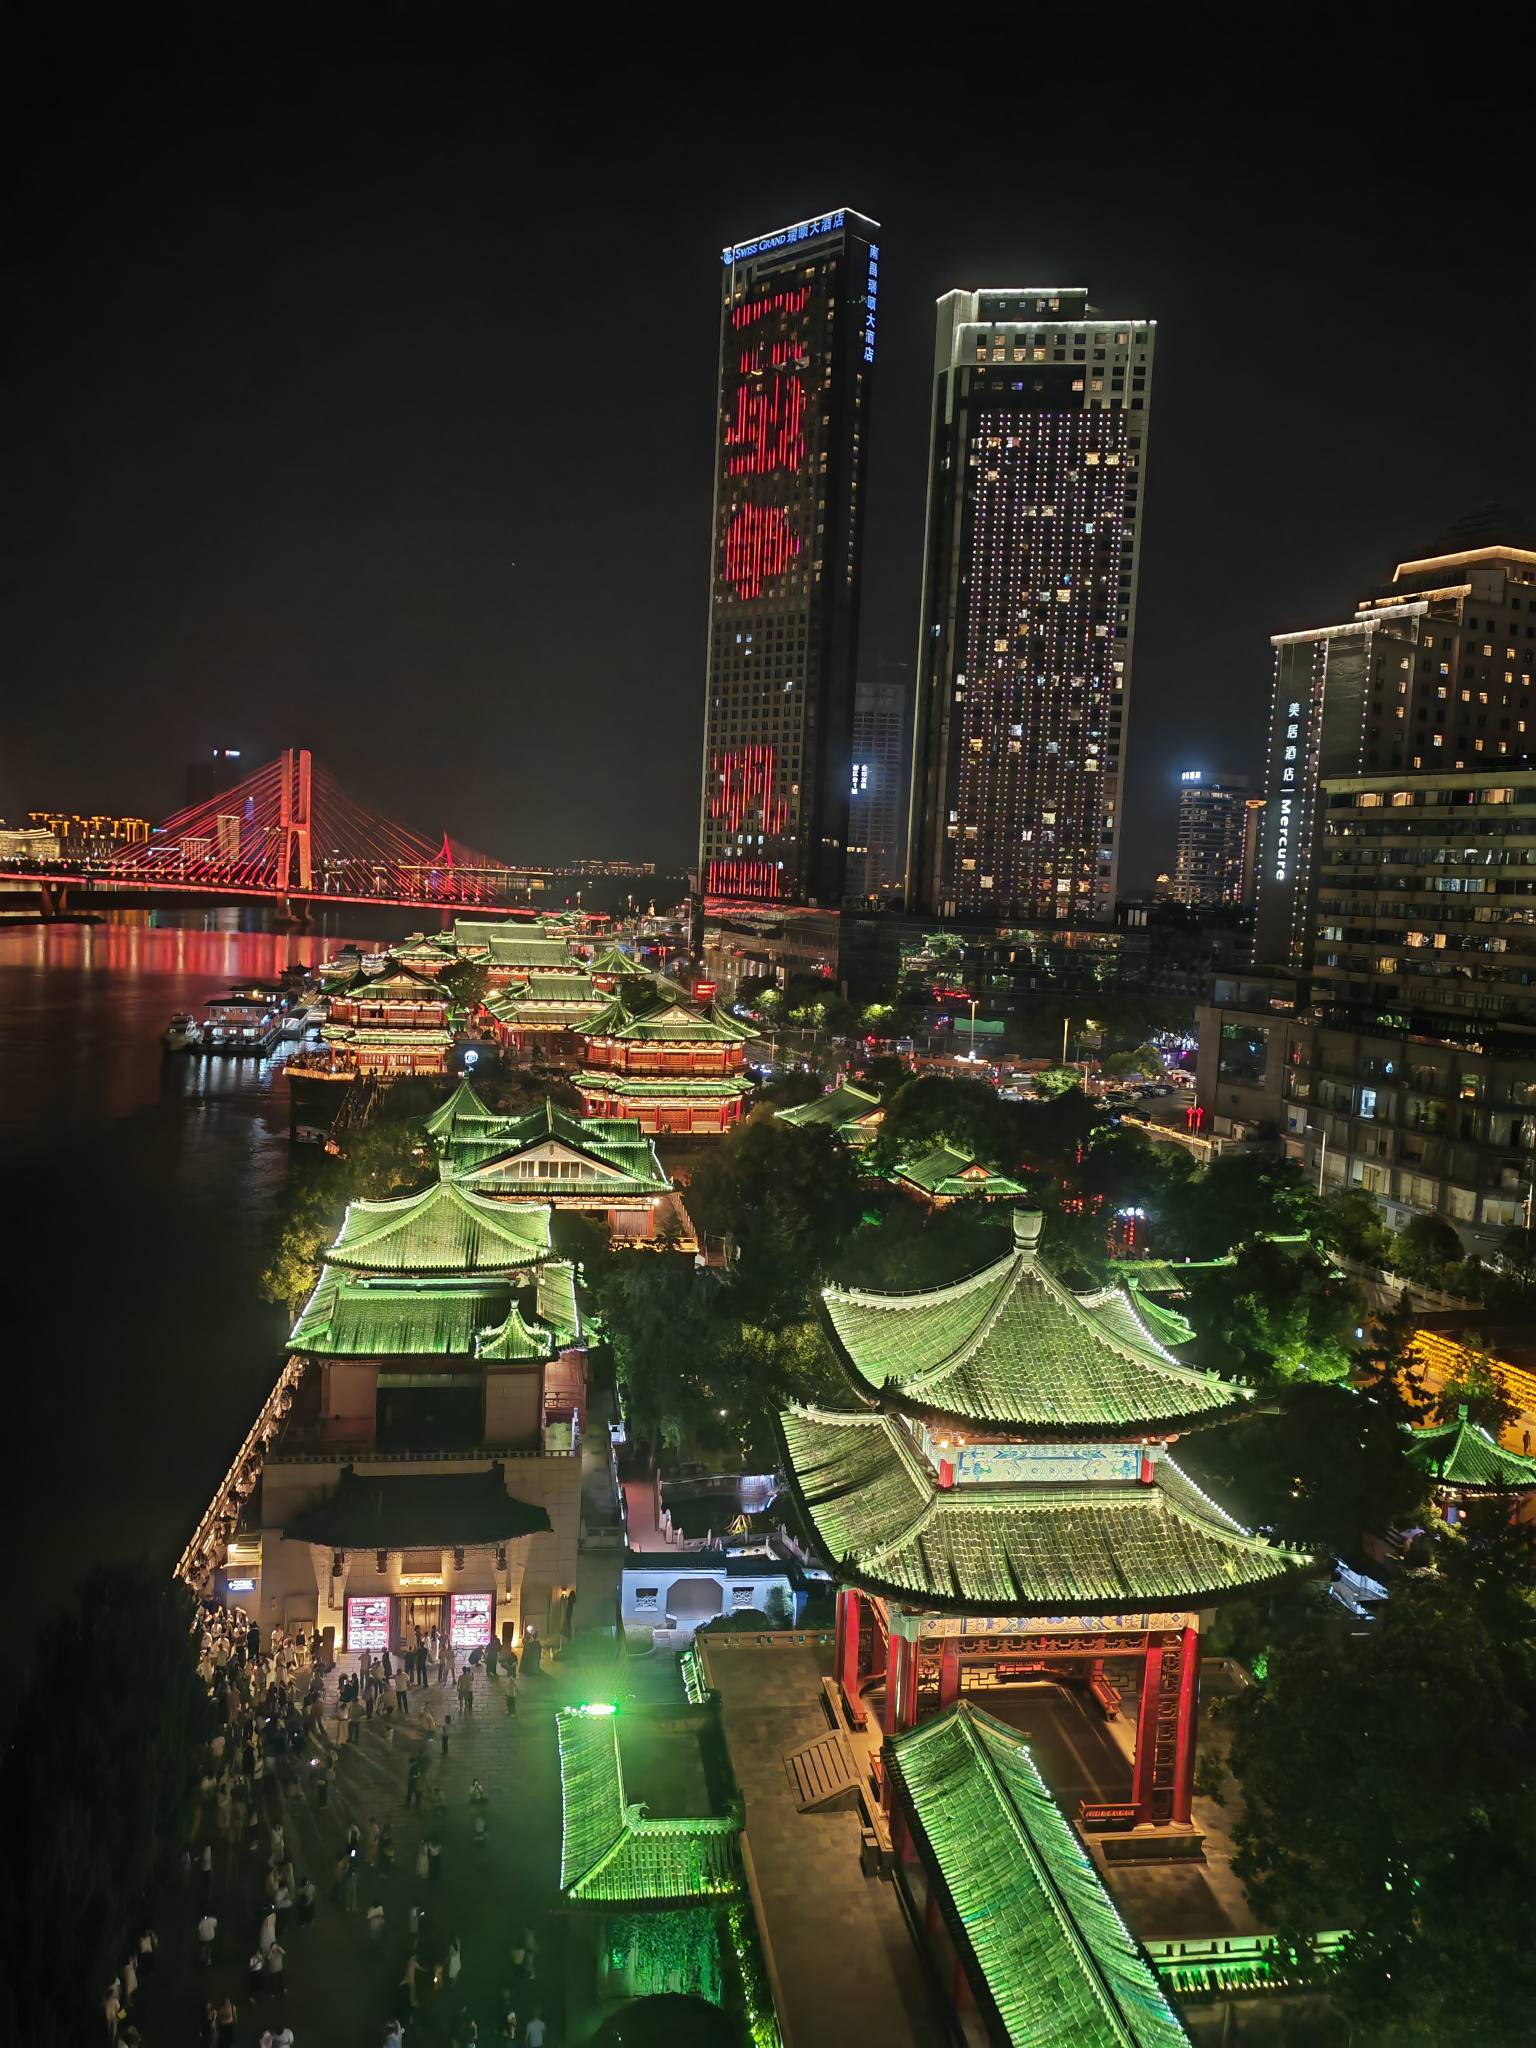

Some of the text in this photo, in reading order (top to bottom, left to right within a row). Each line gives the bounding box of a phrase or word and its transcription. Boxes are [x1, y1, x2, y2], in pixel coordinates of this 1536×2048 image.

[759, 235, 785, 251] GRAND
[1276, 702, 1300, 881] 美居酒店 Mercure
